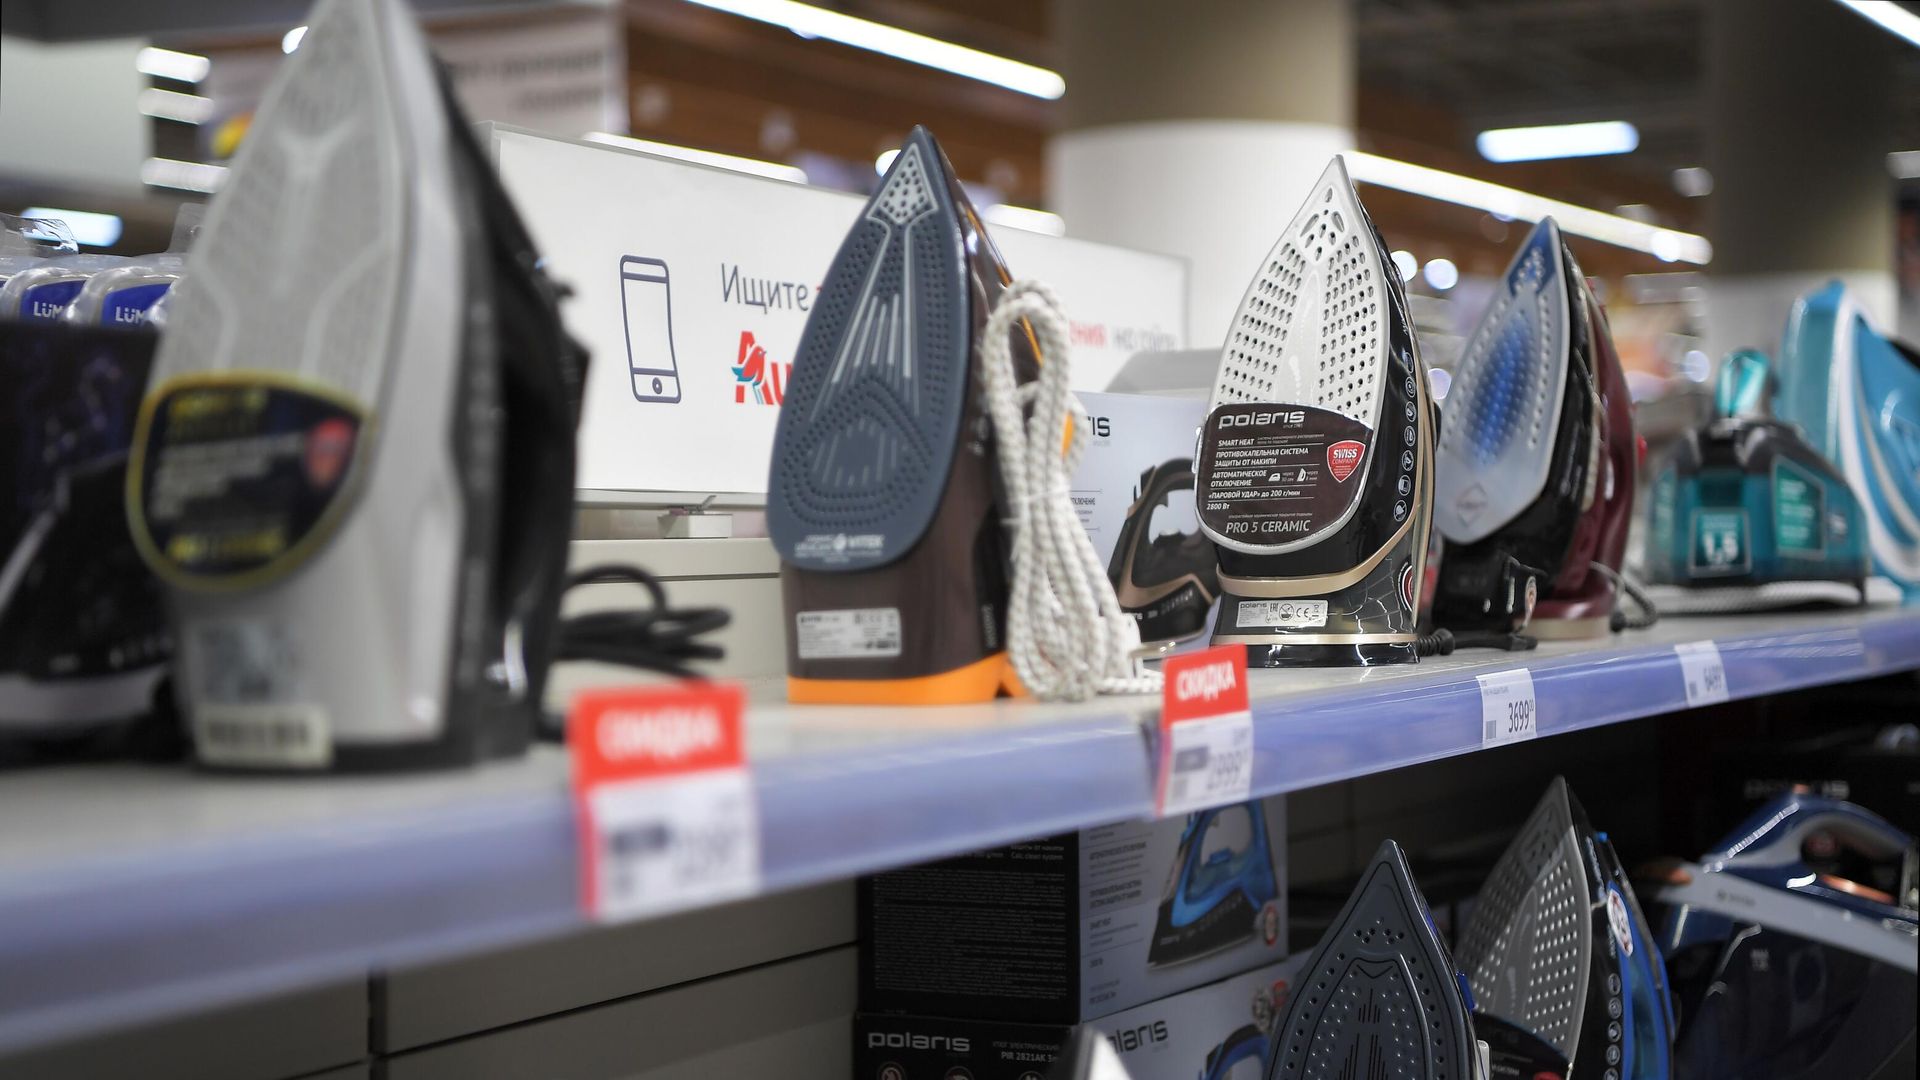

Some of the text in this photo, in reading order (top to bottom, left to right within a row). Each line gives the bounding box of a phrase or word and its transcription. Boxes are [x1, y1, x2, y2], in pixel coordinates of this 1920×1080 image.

[722, 263, 809, 314] Ищите
[1218, 411, 1306, 429] polaris
[1218, 439, 1239, 447] SMART
[1240, 438, 1255, 446] HEAT
[1280, 447, 1309, 455] СИСТЕМА
[1333, 448, 1358, 459] SWISS
[1214, 457, 1277, 467] ЗАЩИТЫ ОТ НАКИПИ
[1212, 470, 1267, 479] АВТОМАТИЧЕСКОЕ
[1211, 479, 1253, 488] ОТКЛЮЧЕНИЕ
[1270, 489, 1283, 497] 200
[1226, 519, 1311, 534] PRO 5 CERAMIC
[1176, 660, 1237, 703] СКИДКА
[1508, 700, 1530, 734] 3699
[868, 1032, 970, 1052] polaris
